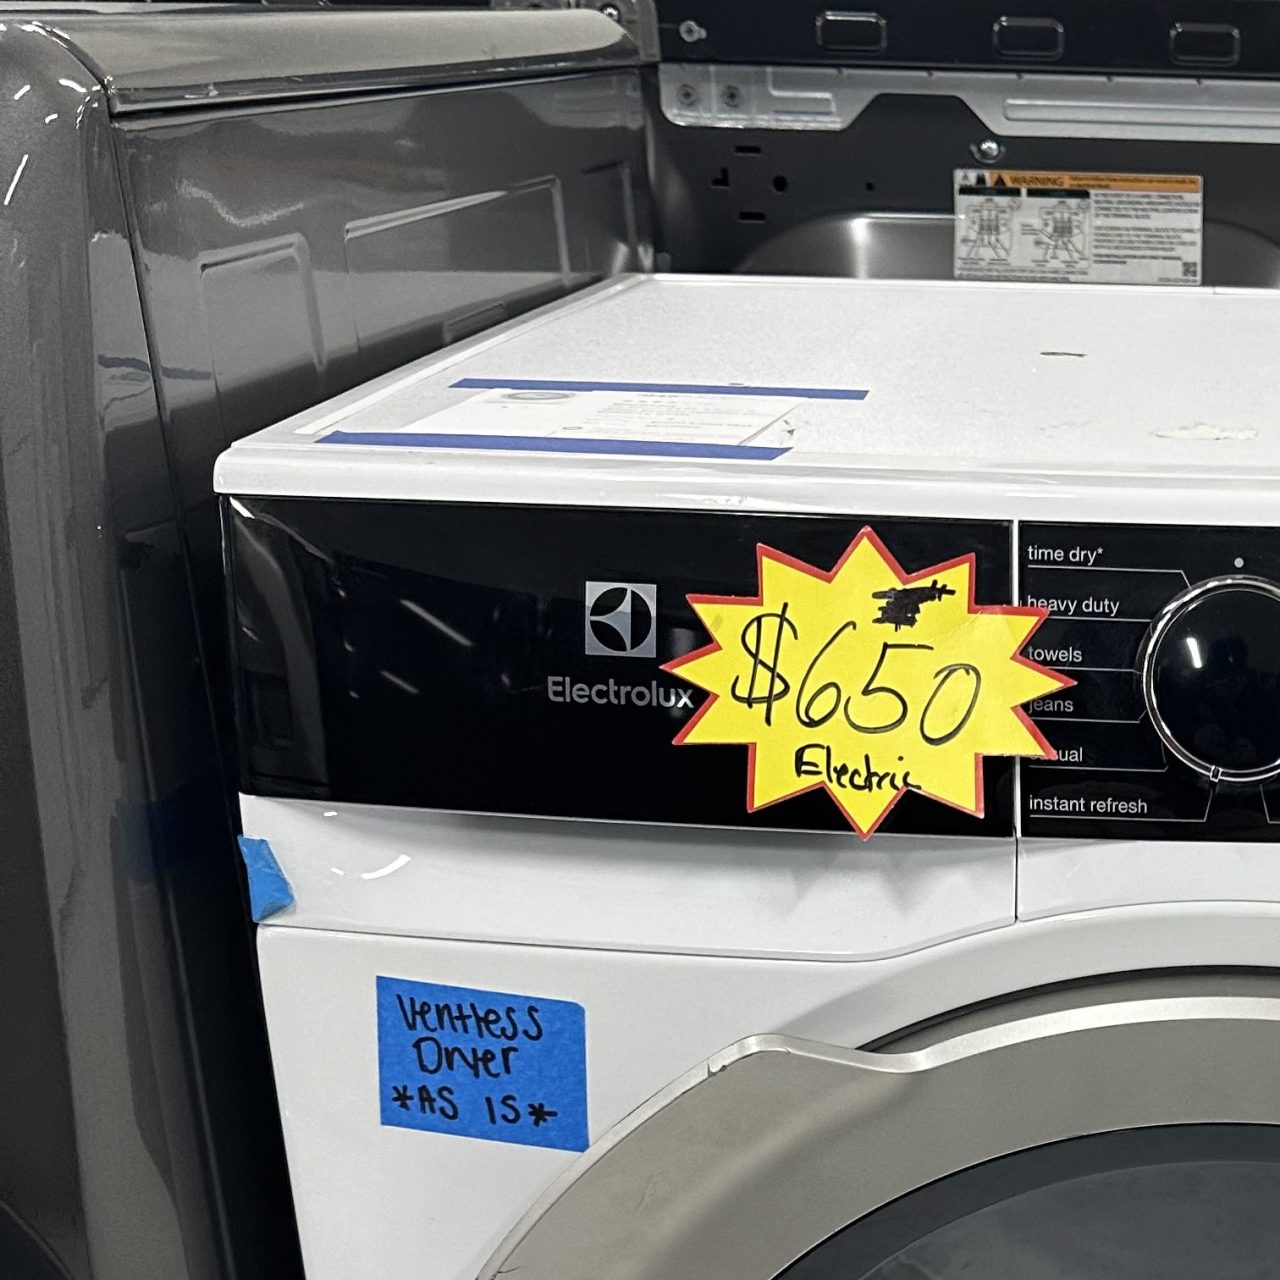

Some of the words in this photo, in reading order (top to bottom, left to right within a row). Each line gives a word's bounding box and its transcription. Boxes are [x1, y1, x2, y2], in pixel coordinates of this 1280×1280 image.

[1009, 175, 1065, 188] WARNING
[1027, 545, 1064, 562] time
[1027, 595, 1078, 617] heavy
[1082, 597, 1120, 617] duty
[1028, 646, 1083, 662] towels
[731, 602, 982, 746] $650
[548, 675, 695, 709] Electrolux
[1028, 698, 1075, 715] jeans
[1030, 746, 1084, 763] sual
[795, 743, 923, 794] Electric
[1029, 796, 1086, 813] instant
[1090, 797, 1148, 814] refresh
[397, 994, 544, 1041] Ventless
